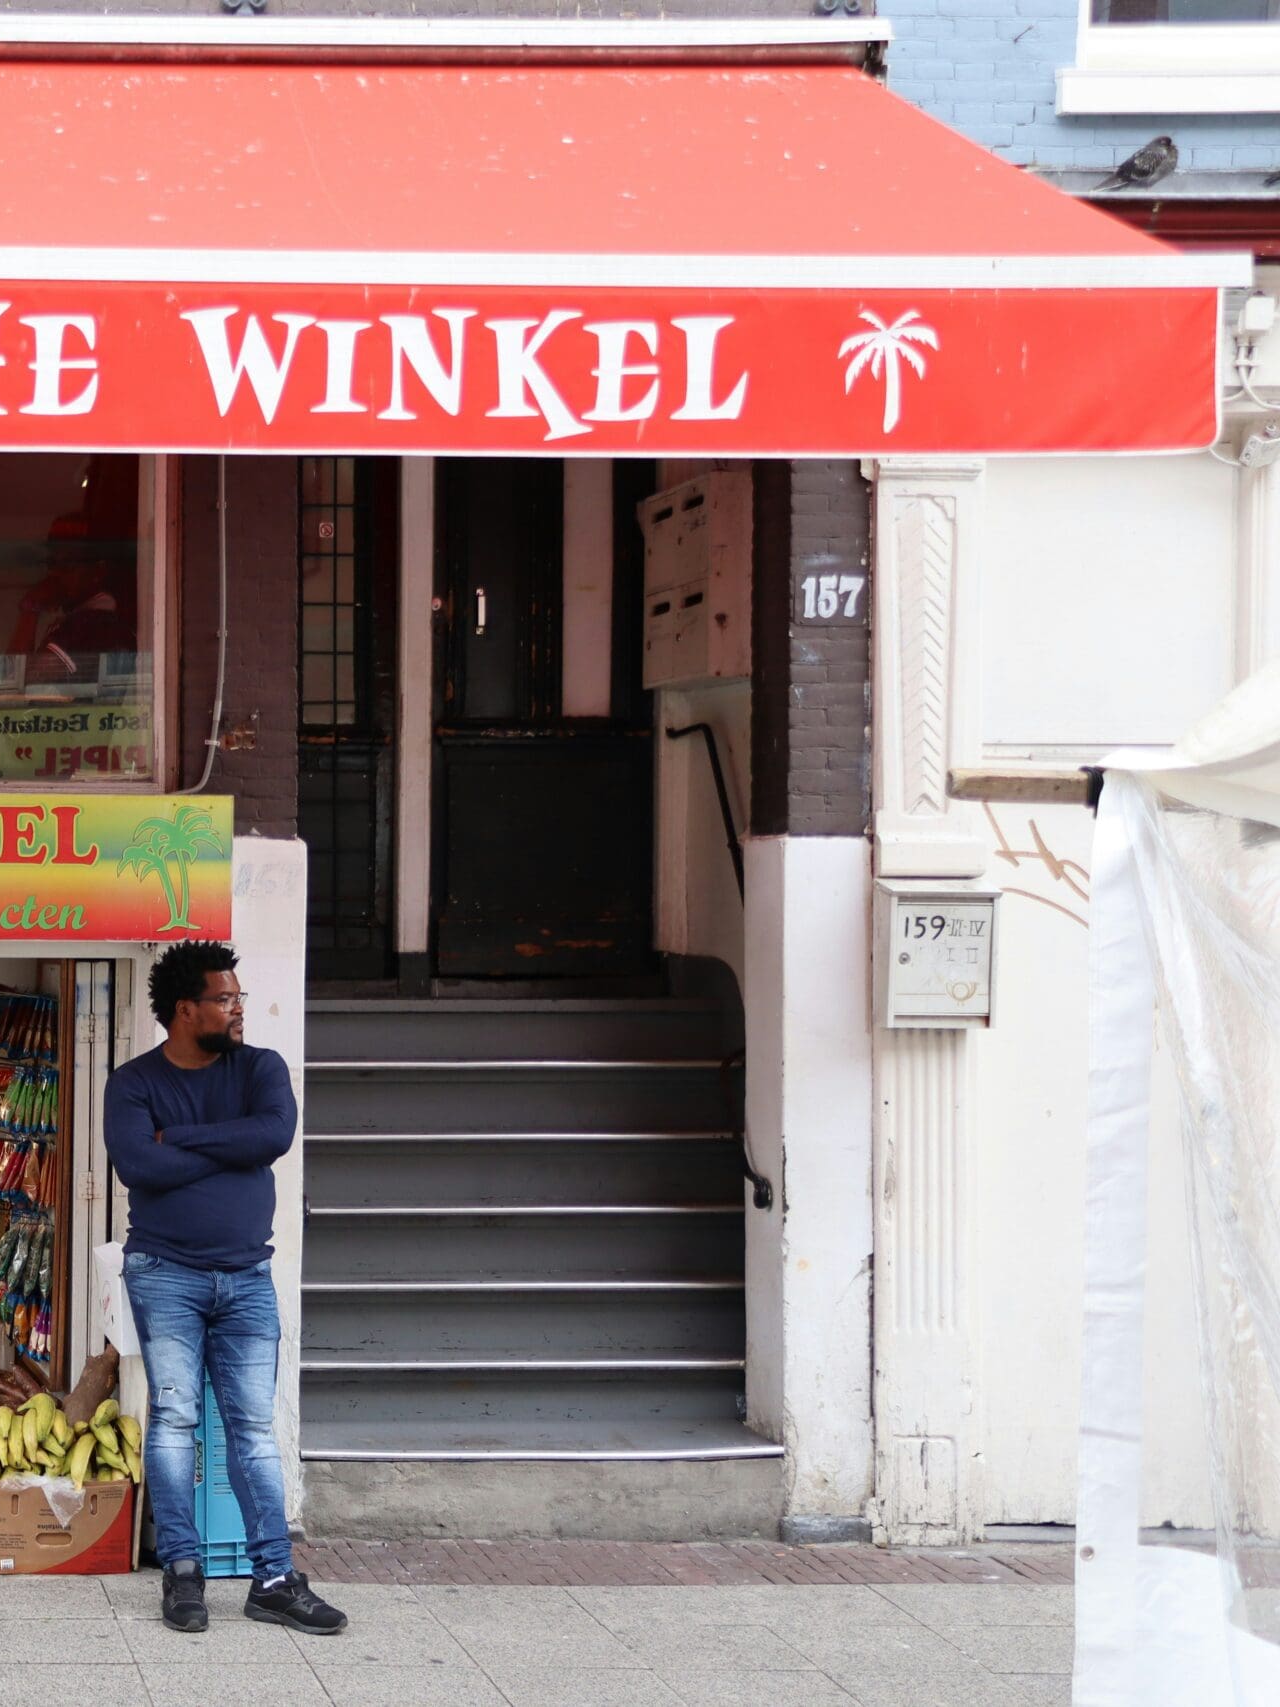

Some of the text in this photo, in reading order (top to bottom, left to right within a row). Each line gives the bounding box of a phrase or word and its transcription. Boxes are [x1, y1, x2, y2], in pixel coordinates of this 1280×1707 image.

[179, 307, 749, 442] WINKEL
[801, 574, 865, 619] 157
[904, 915, 946, 940] 159
